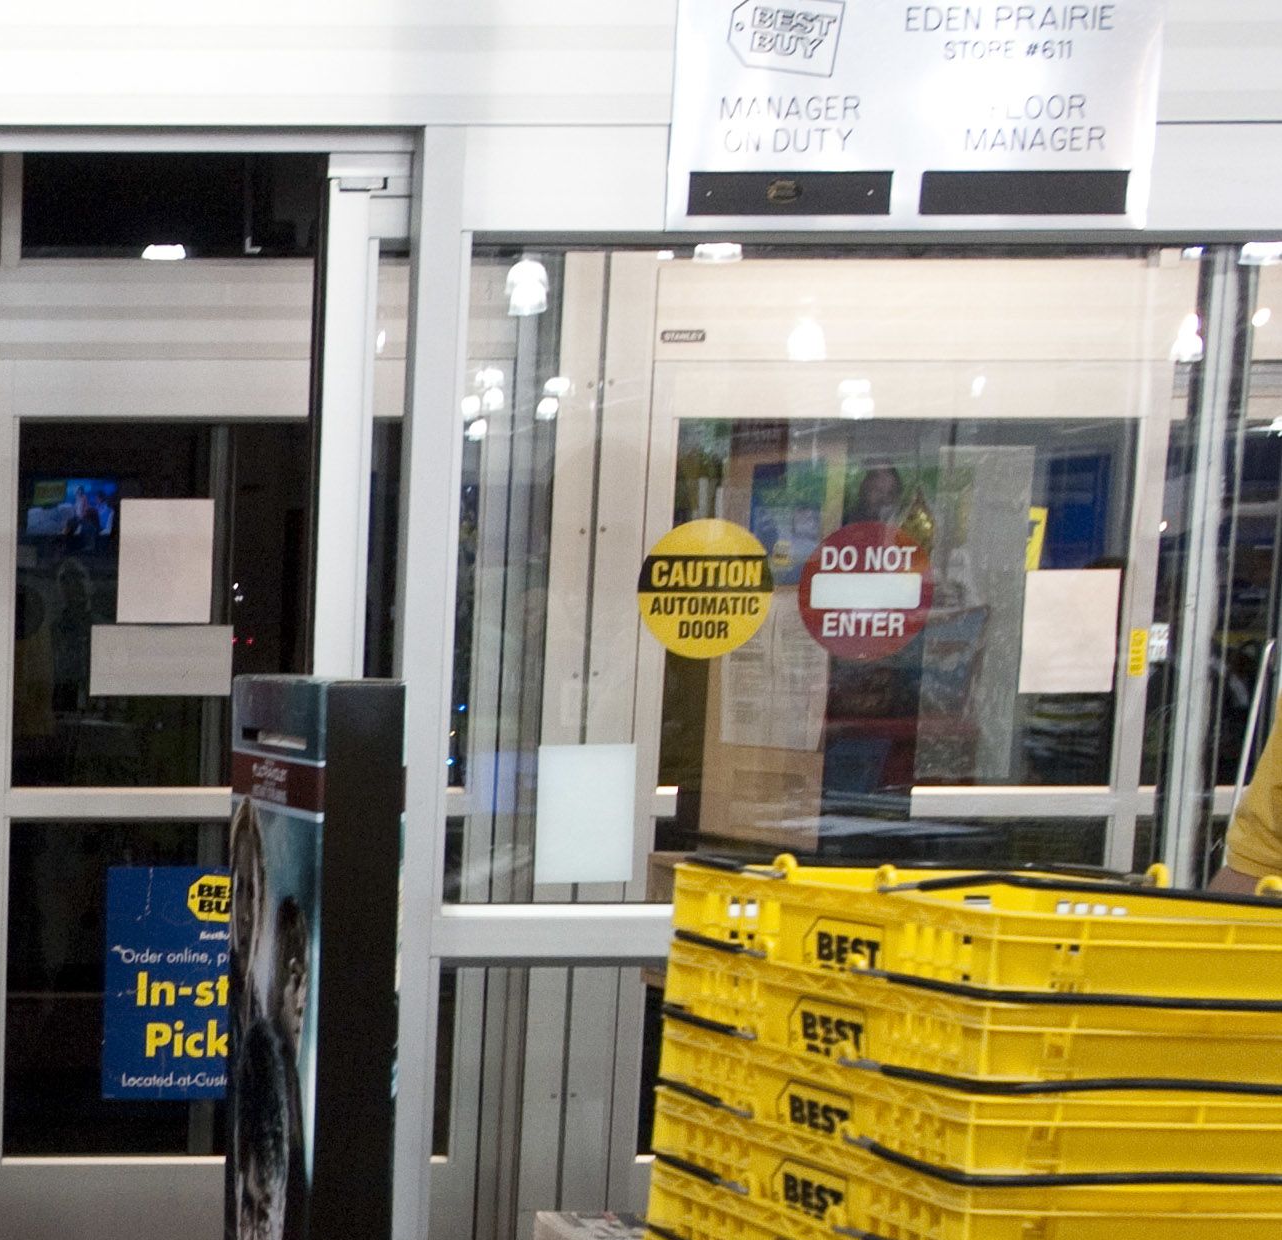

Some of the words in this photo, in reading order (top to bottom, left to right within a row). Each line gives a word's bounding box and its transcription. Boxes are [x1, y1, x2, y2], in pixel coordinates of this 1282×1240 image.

[750, 6, 837, 36] BEST
[905, 5, 982, 31] EDEN
[995, 4, 1115, 31] PRAIRIE
[750, 31, 823, 60] BUY
[1025, 39, 1075, 60] #611
[719, 96, 862, 121] MANAGER
[773, 128, 854, 153] DUTY
[964, 126, 1108, 152] MANAGER
[820, 546, 857, 572] DO
[865, 546, 918, 572] NOT
[651, 560, 763, 587] CAUTION
[650, 596, 760, 616] AUTOMATIC
[678, 620, 729, 639] DOOR
[821, 612, 906, 638] ENTER
[197, 884, 232, 899] BE
[121, 949, 161, 964] Order
[167, 948, 209, 964] online,
[817, 931, 880, 968] BEST
[145, 1020, 229, 1058] Pick
[802, 1012, 863, 1055] BEST
[122, 1072, 174, 1087] Located
[177, 1073, 191, 1087] at
[789, 1095, 849, 1132] BEST
[783, 1172, 843, 1214] BEST
